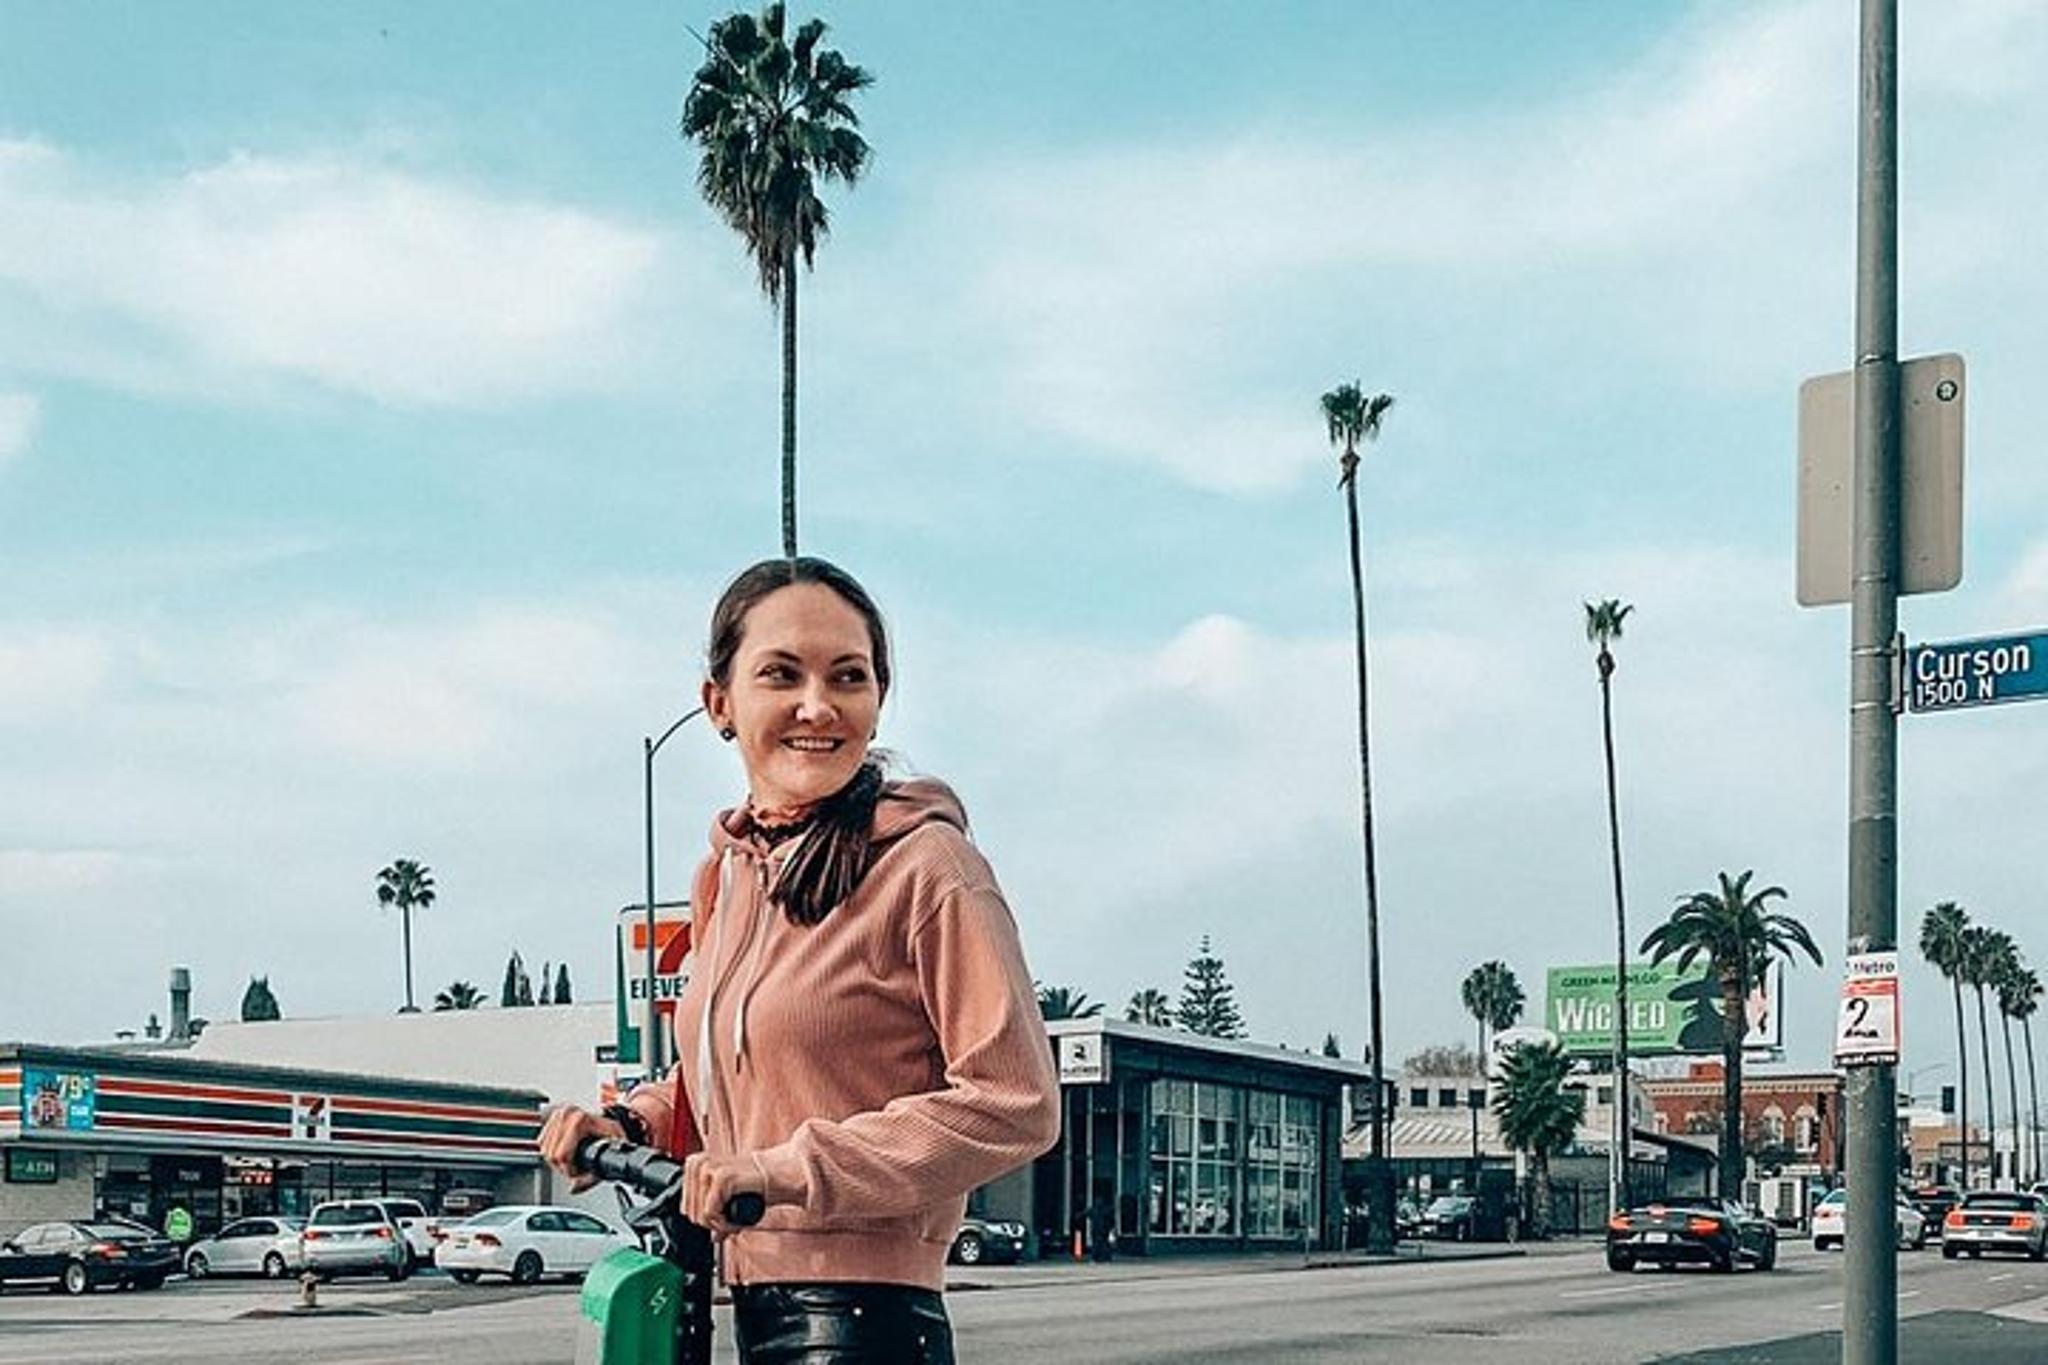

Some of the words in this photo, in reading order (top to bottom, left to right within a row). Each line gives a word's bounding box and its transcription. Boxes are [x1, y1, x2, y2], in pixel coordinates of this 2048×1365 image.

[1917, 645, 2030, 681] Curson
[1916, 680, 1967, 706] 1500
[1979, 676, 1994, 698] N
[631, 976, 689, 999] ELEVE
[1555, 997, 1666, 1033] WiCED
[1843, 997, 1879, 1038] 2
